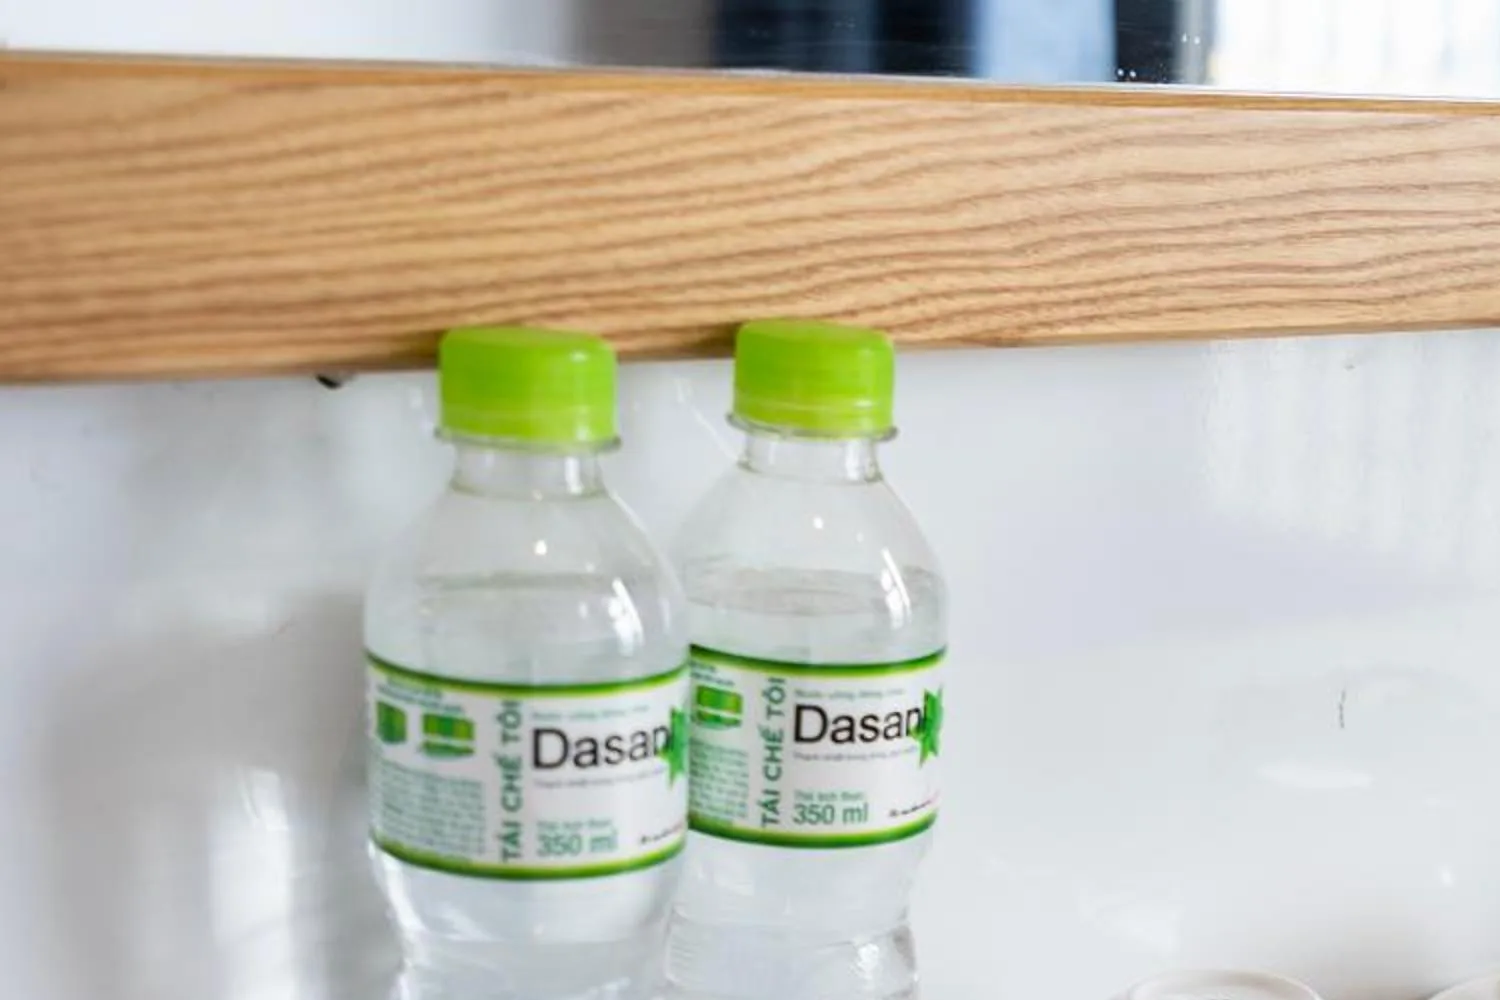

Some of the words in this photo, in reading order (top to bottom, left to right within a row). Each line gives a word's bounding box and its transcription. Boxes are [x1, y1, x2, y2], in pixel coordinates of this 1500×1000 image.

[793, 804, 835, 826] 350
[842, 802, 869, 825] ml
[537, 833, 581, 857] 350
[590, 829, 618, 853] ml
